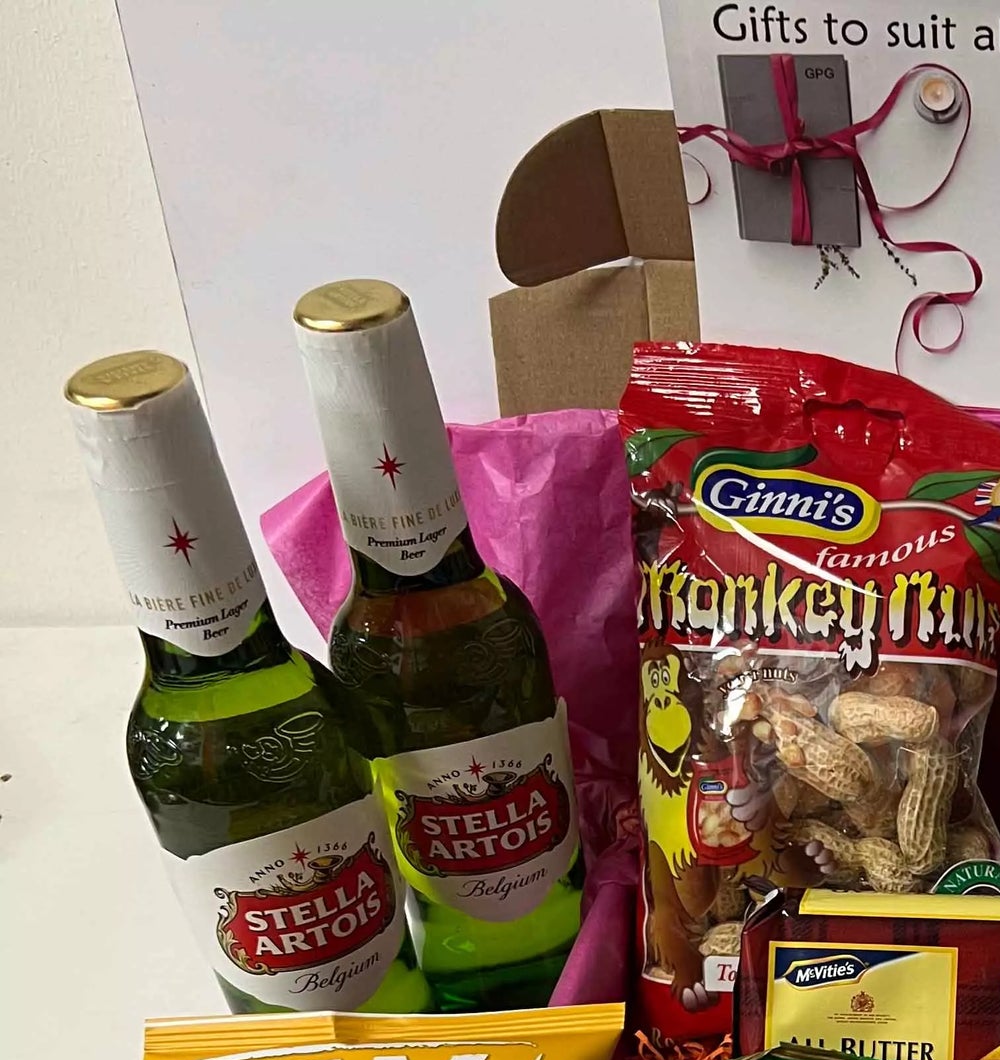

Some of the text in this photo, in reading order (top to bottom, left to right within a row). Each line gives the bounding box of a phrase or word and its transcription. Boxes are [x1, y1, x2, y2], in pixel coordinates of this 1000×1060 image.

[713, 4, 808, 45] Gifts
[824, 13, 868, 47] to
[887, 17, 956, 50] suit
[805, 67, 835, 81] GPG
[709, 478, 857, 527] Ginni's
[367, 527, 447, 548] Premium Lager
[400, 550, 426, 561] Beer
[814, 523, 955, 570] famous
[763, 666, 798, 684] nuts
[421, 789, 547, 836] STELLA
[428, 809, 554, 861] ARTOIS
[248, 840, 350, 885] ANNO 1366
[456, 866, 549, 901] Belgium
[244, 870, 376, 933] STELLA
[255, 894, 382, 957] ARTOIS
[288, 949, 381, 994] Belgium
[795, 960, 855, 984] McVitie's
